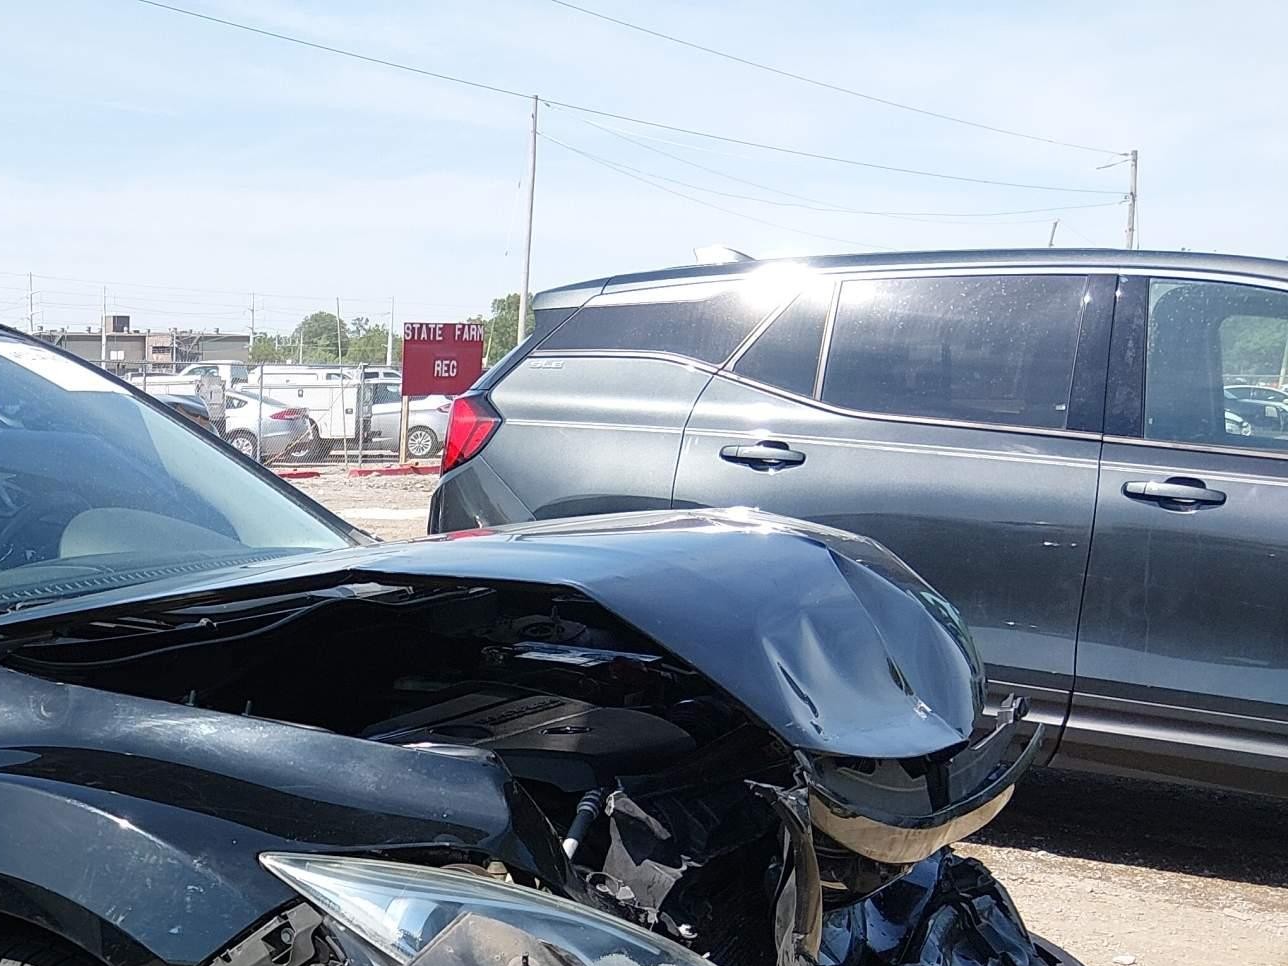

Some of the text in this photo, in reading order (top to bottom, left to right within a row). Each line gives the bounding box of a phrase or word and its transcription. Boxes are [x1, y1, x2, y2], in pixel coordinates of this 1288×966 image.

[404, 323, 484, 341] STATE FARM
[434, 359, 457, 377] REG
